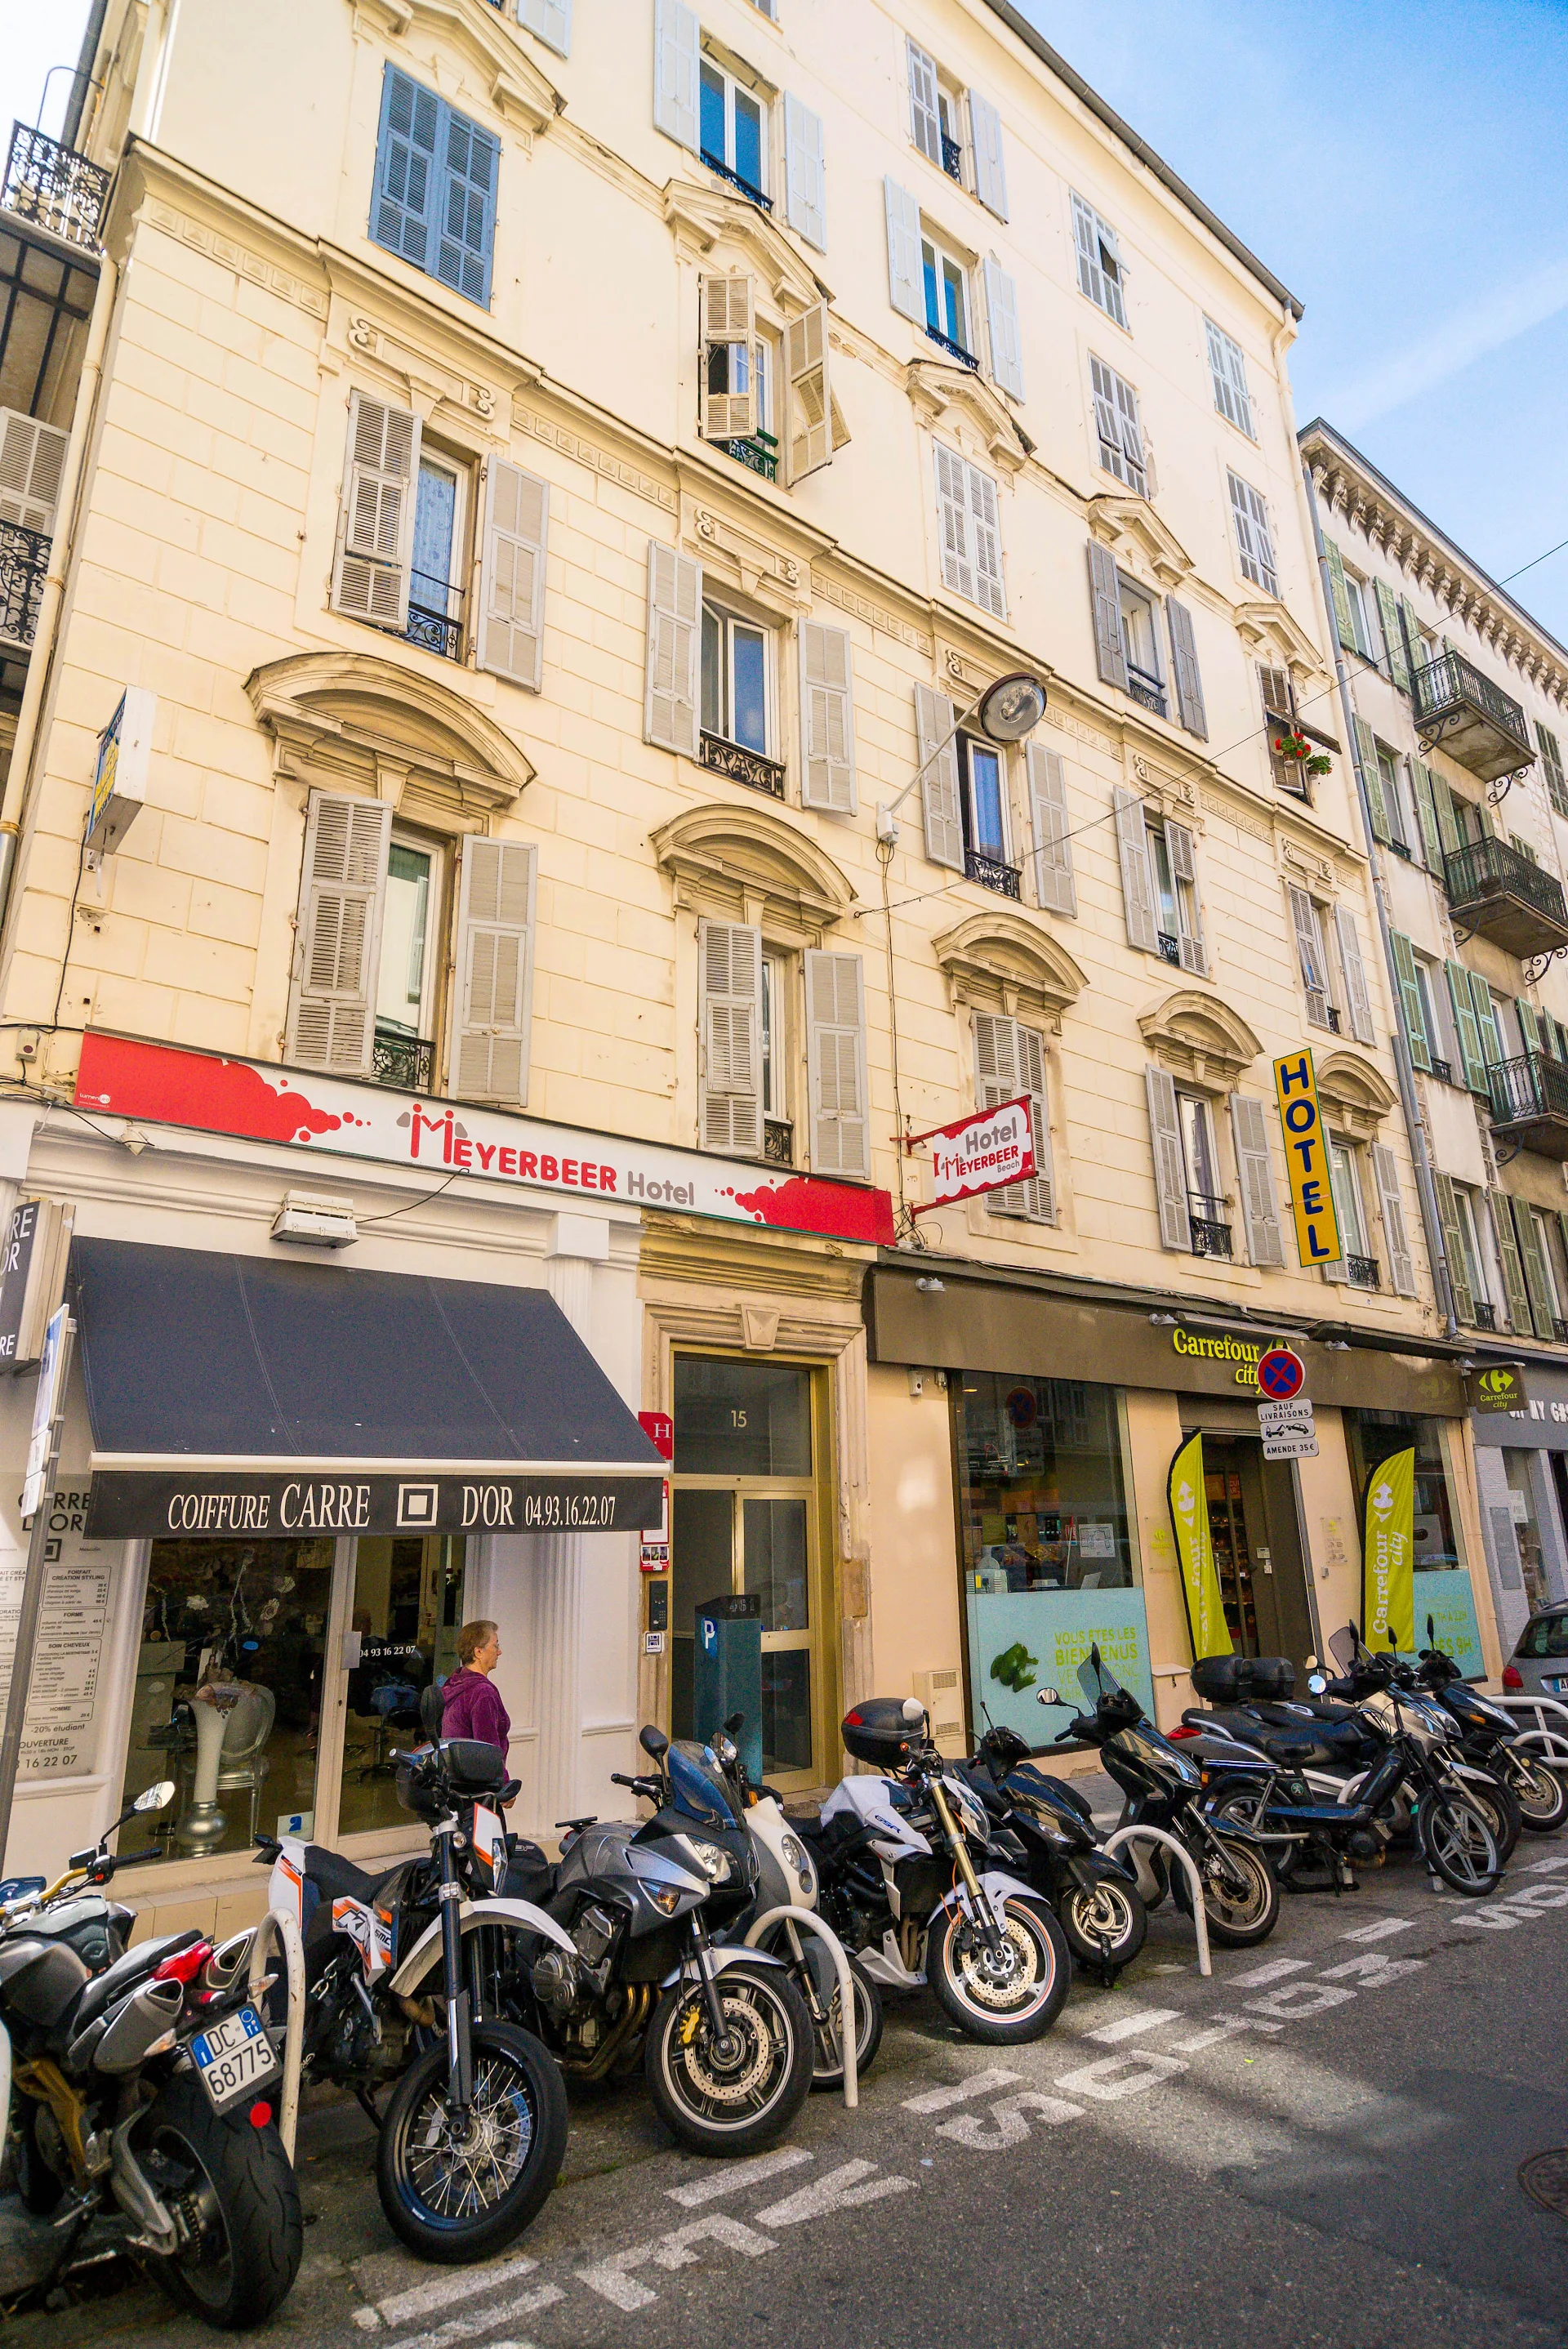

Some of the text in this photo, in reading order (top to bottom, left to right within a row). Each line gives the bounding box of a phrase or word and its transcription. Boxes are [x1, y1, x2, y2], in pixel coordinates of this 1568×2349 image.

[965, 1117, 1018, 1156] Hotel
[410, 1103, 694, 1206] MEYERBEER Hotel
[945, 1145, 1019, 1181] MEYERBEER
[1280, 1057, 1330, 1258] HOTEL
[996, 1160, 1020, 1174] Beach
[1173, 1328, 1260, 1363] Carrefour
[1480, 1392, 1518, 1402] Carrefour
[1493, 1401, 1508, 1410] city
[1260, 1409, 1309, 1420] LIVRAISONS
[1272, 1403, 1294, 1411] SAUF
[731, 1410, 747, 1429] 15
[654, 1423, 671, 1438] H
[1267, 1445, 1296, 1455] AMENDE
[167, 1483, 616, 1530] COIFFURE CARRE D'OR 04.93.16.22.07
[1389, 1531, 1409, 1567] city
[1372, 1531, 1388, 1634] Carrefour
[1054, 1630, 1085, 1646] VOUS
[1117, 1627, 1137, 1641] LES
[371, 1647, 381, 1657] 93
[383, 1647, 392, 1656] 16
[394, 1646, 404, 1656] 22
[406, 1645, 416, 1655] 07
[1055, 1643, 1138, 1666] BIENENUS
[53, 1723, 85, 1732] étudiant
[19, 1737, 69, 1749] OUVERTURE
[25, 1758, 39, 1768] 16
[43, 1756, 58, 1767] 22
[62, 1754, 78, 1765] 07
[206, 2023, 236, 2057] DC
[207, 2039, 272, 2096] 68775
